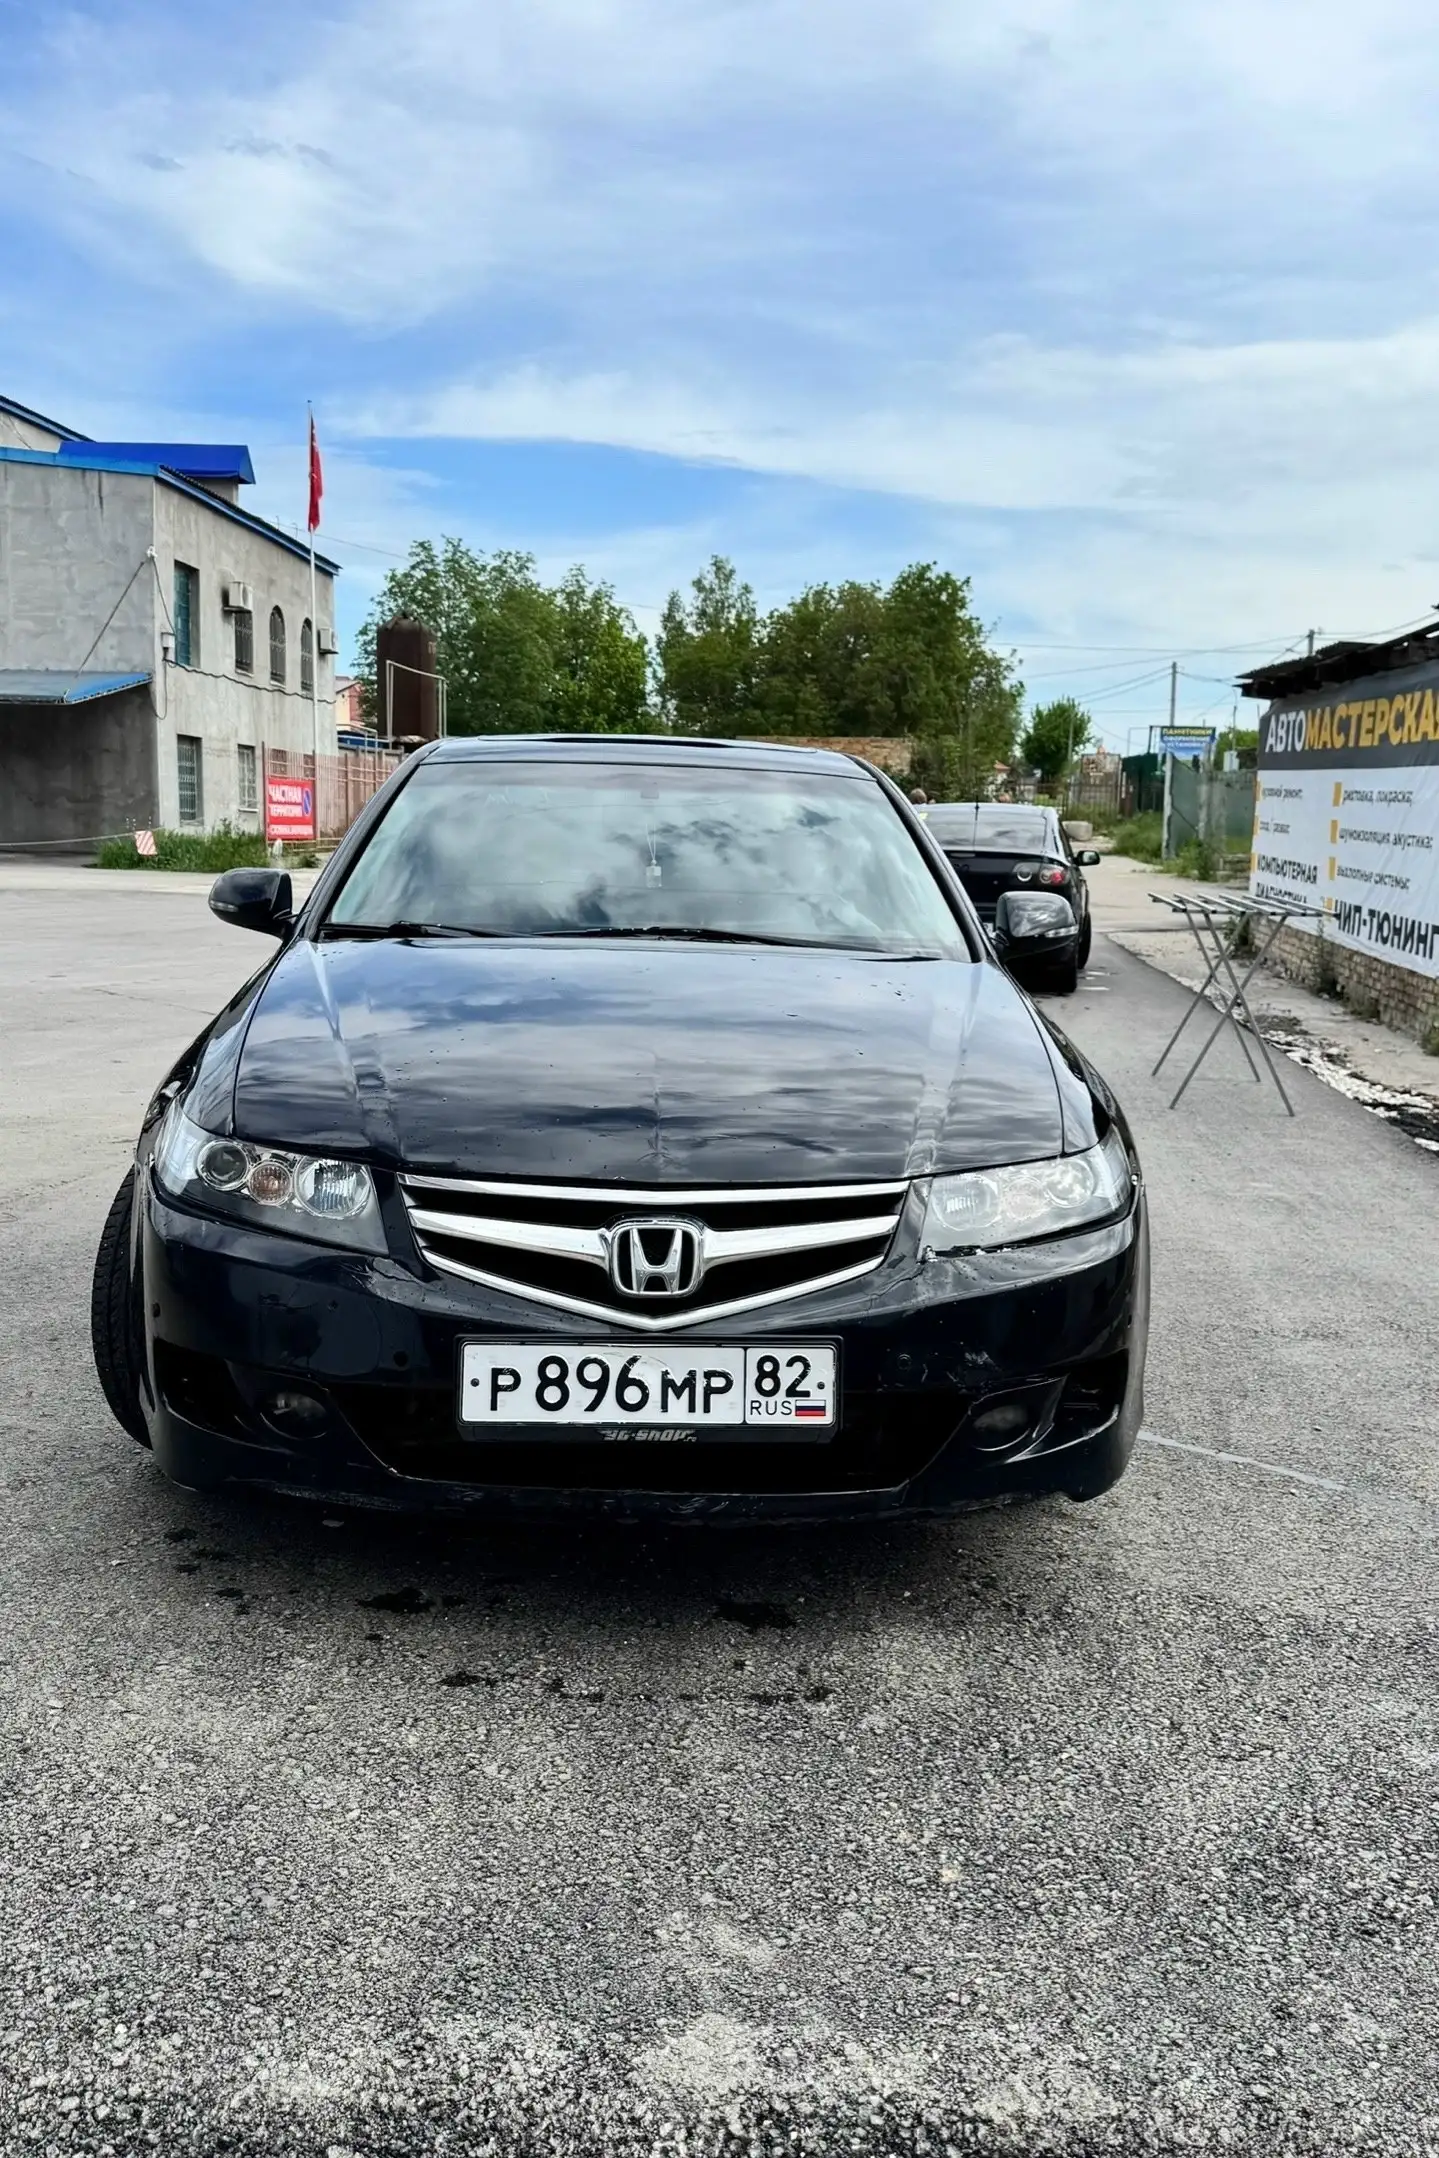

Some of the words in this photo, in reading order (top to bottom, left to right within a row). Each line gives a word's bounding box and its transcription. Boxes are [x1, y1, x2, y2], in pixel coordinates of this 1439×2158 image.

[268, 784, 302, 803] ЧАСТНАЯ
[1257, 853, 1318, 885] КОМПЬЮТЕРНАЯ
[1334, 900, 1439, 960] ЧИП-ТЮНИНГ
[754, 1354, 811, 1398] 82
[749, 1400, 792, 1415] RUS
